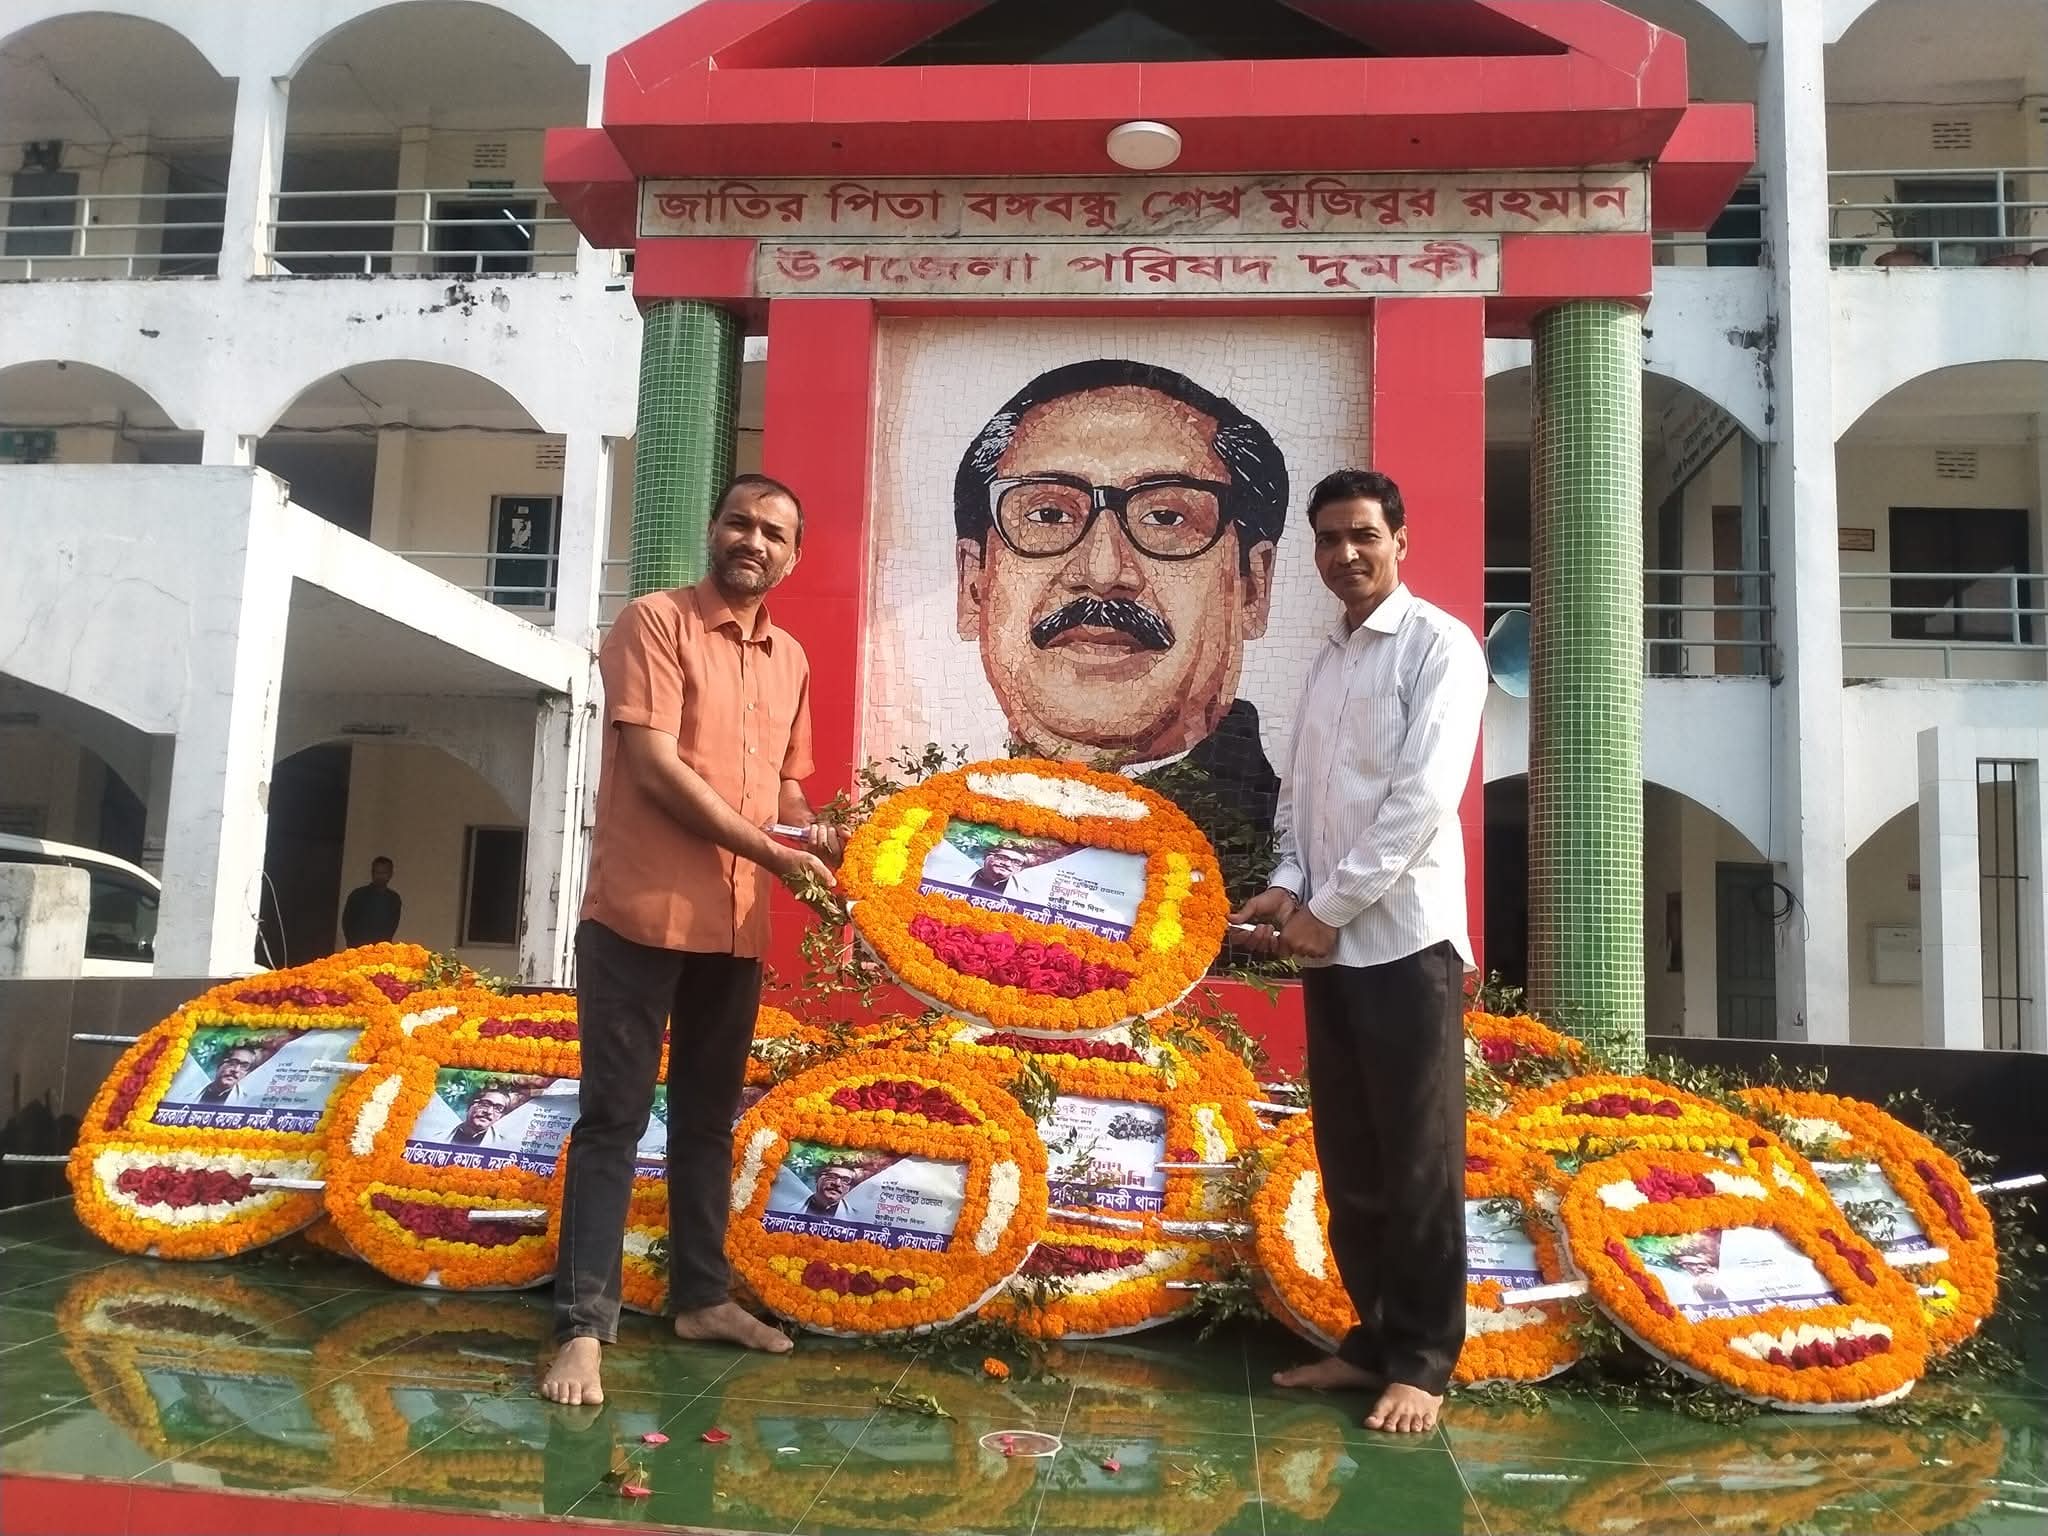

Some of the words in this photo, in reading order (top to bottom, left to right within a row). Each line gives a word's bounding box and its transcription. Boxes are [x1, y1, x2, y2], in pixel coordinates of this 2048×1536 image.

[653, 182, 808, 225] জাতির
[824, 183, 945, 223] পিতা
[963, 191, 1122, 229] বঙ্গবন্ধু
[1142, 184, 1247, 219] শেখ
[1260, 177, 1437, 229] মুজিবুর
[1458, 184, 1632, 222] রহমান
[775, 246, 1040, 283] উপজেলা
[1066, 246, 1277, 285] পরিষদ
[1298, 242, 1485, 289] দুমকী
